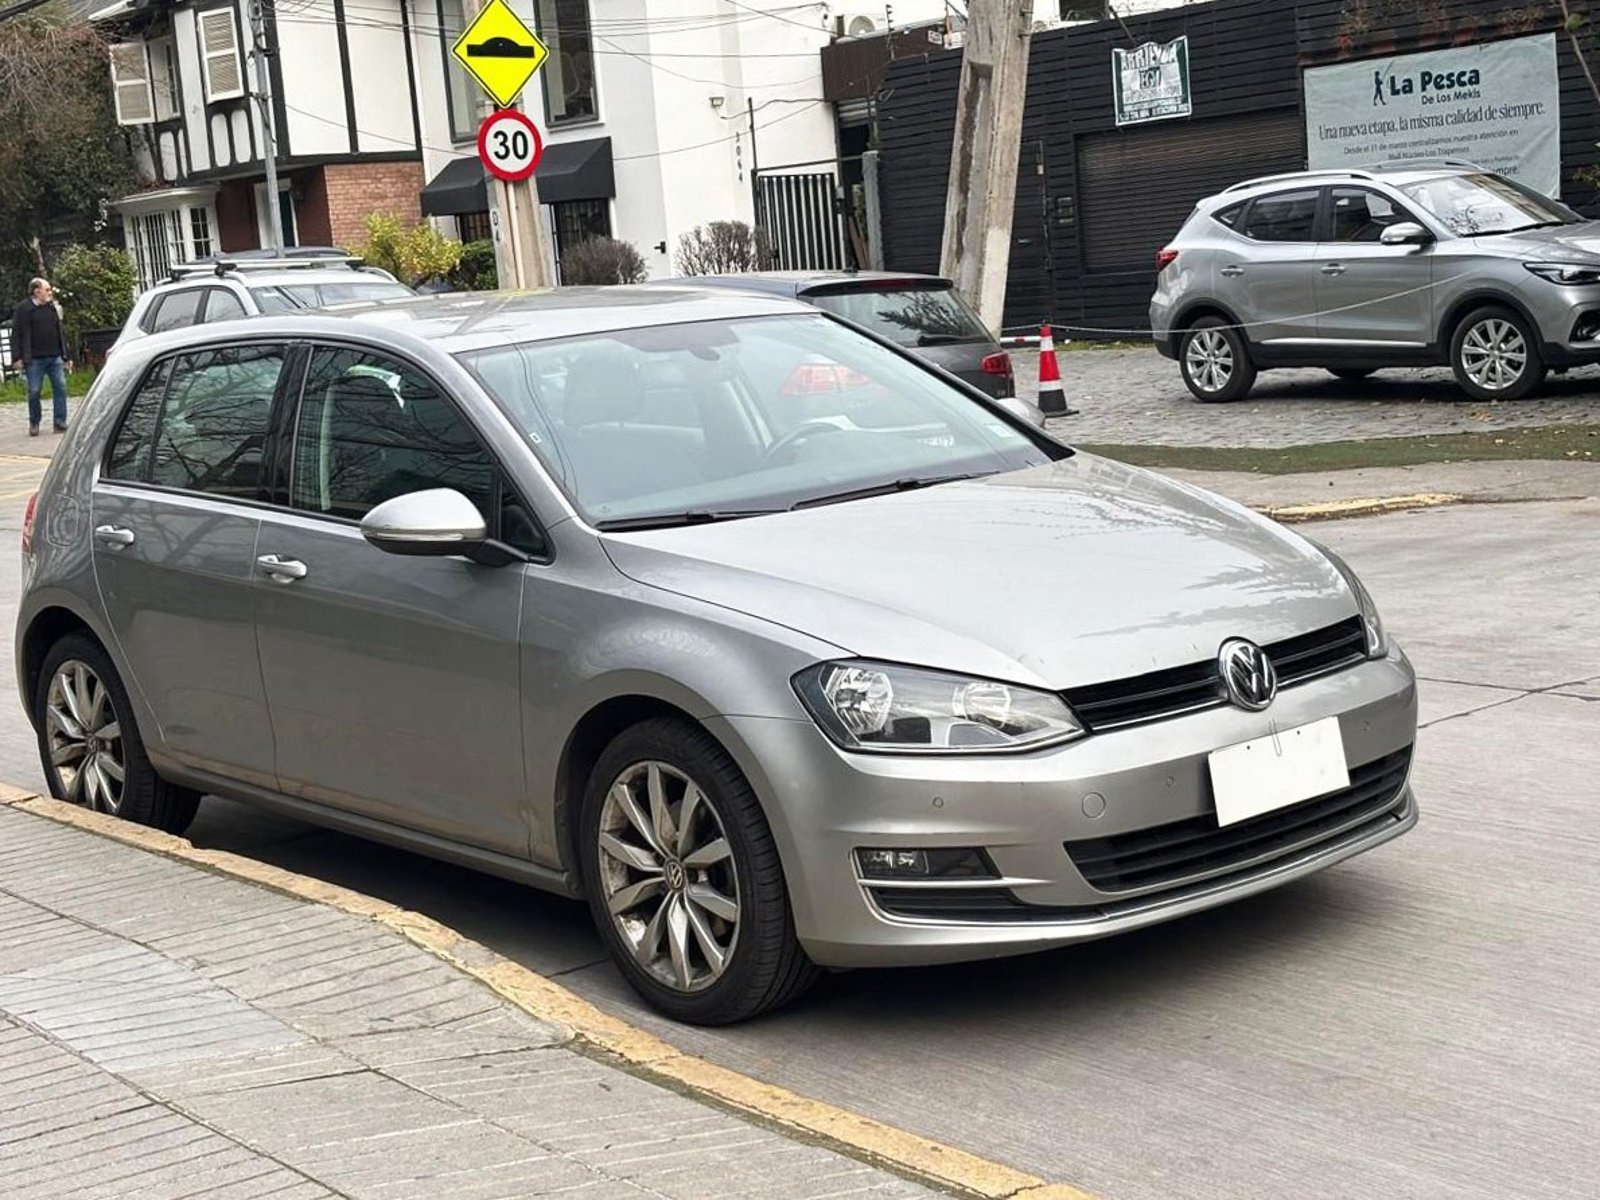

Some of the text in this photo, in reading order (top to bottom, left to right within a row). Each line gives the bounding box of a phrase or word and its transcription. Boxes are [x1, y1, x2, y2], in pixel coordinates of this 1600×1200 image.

[1389, 69, 1480, 96] La Pesca
[1421, 88, 1481, 105] De Los Mekis
[1319, 125, 1338, 140] Una
[1338, 124, 1367, 138] nueva
[1399, 116, 1409, 131] la
[1409, 114, 1445, 129] misma
[1445, 105, 1483, 126] calidad
[1484, 105, 1499, 121] de
[1498, 101, 1546, 120] siempre.
[493, 130, 529, 160] 30
[1222, 638, 1276, 711] VW
